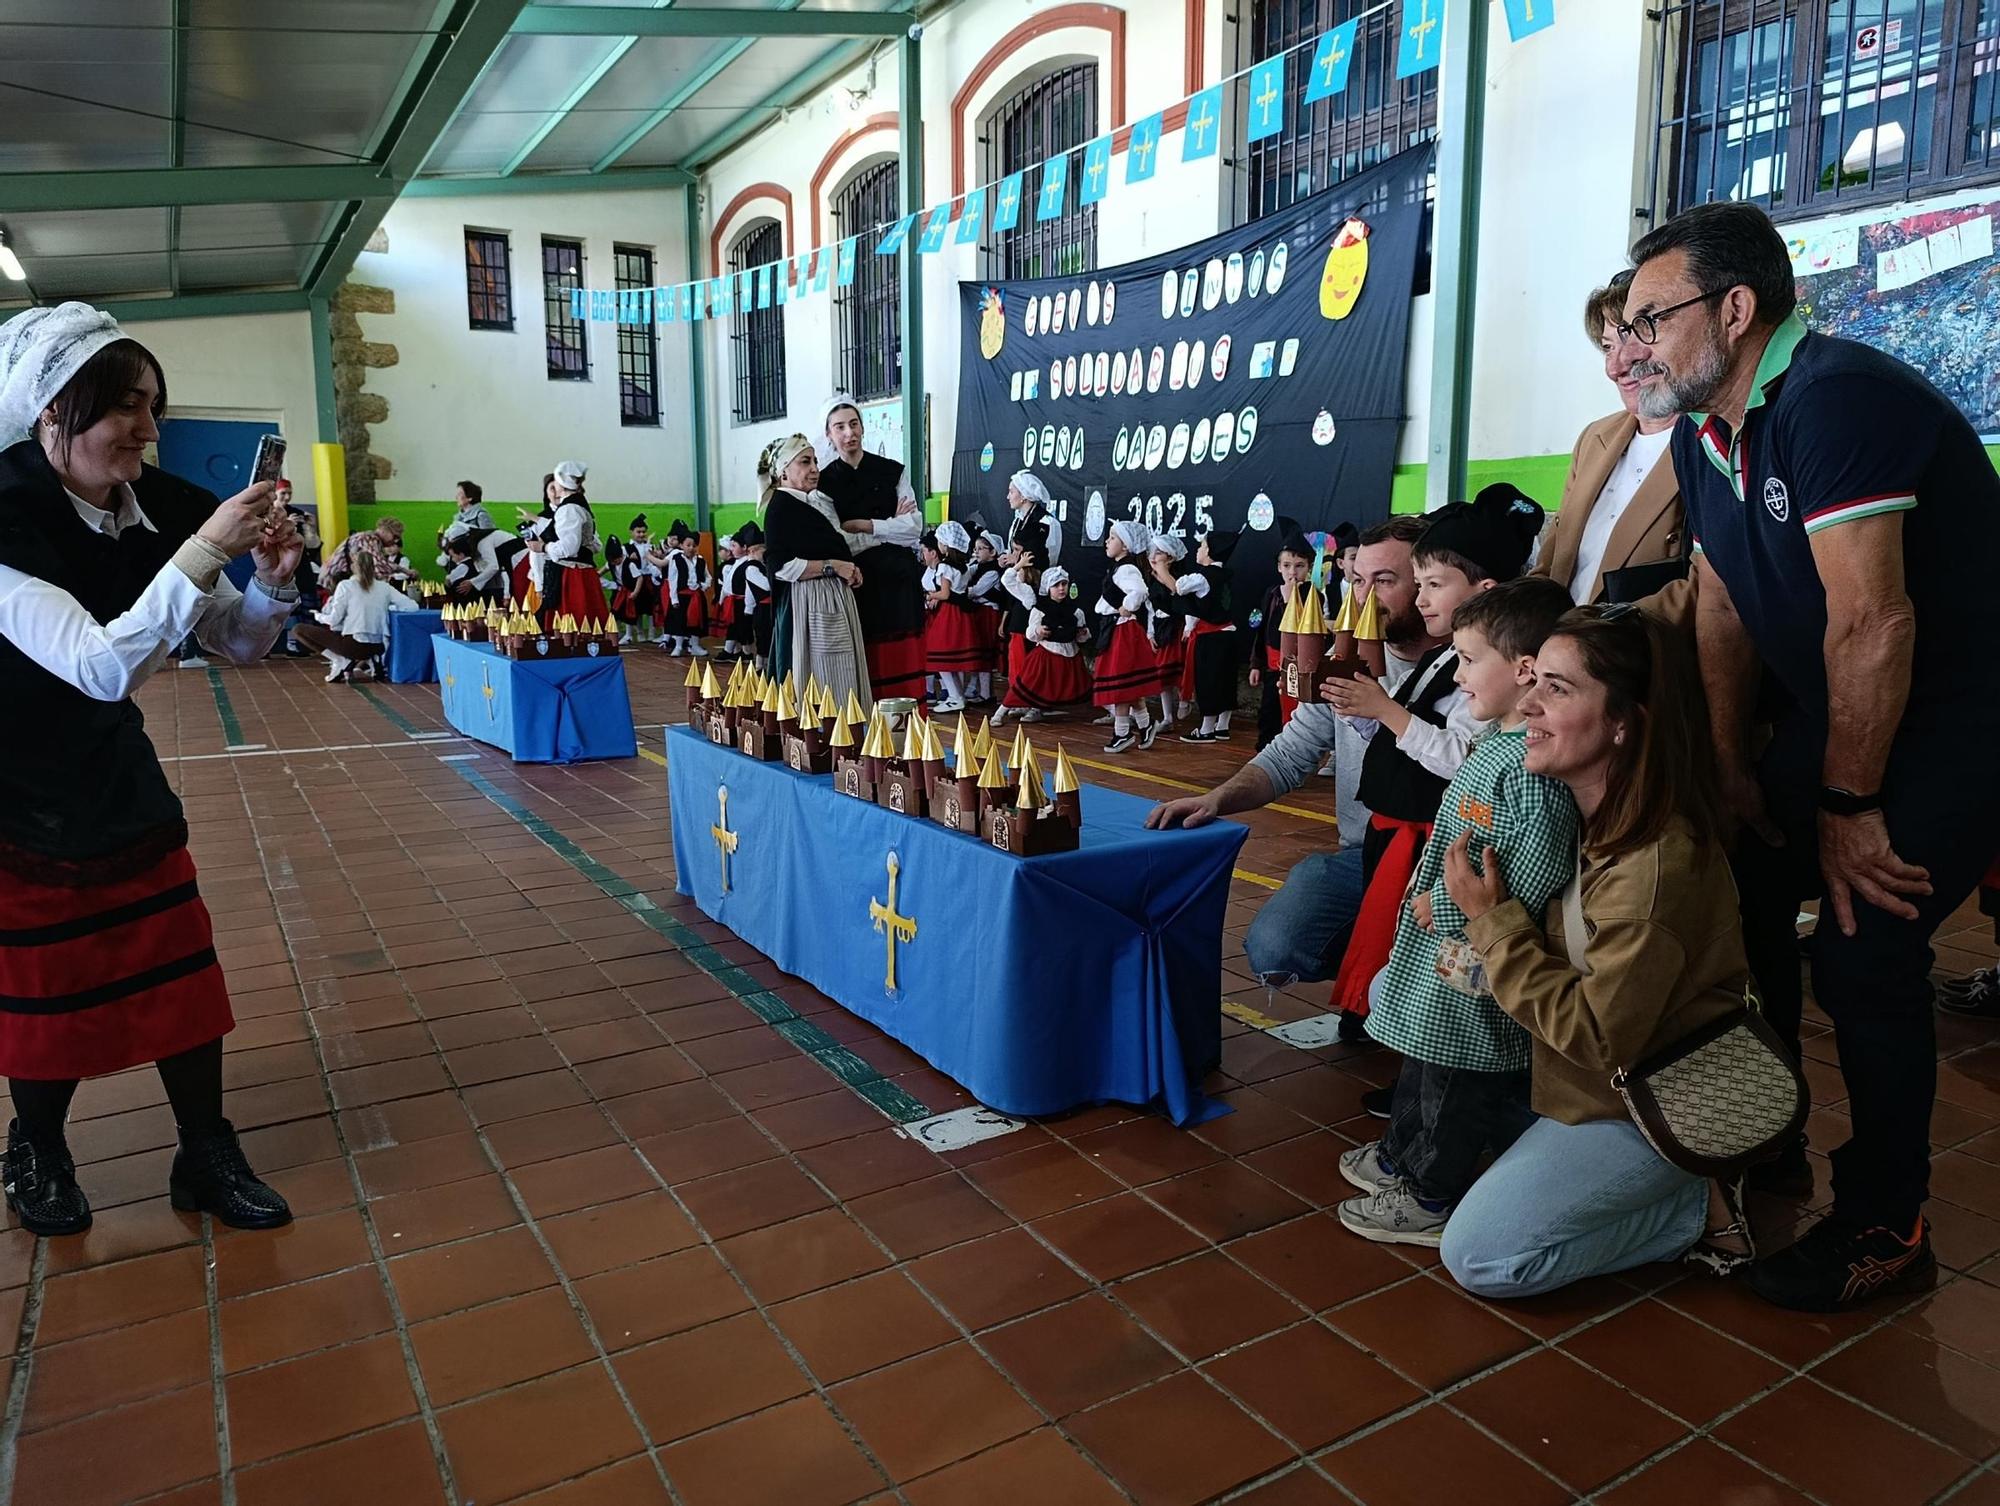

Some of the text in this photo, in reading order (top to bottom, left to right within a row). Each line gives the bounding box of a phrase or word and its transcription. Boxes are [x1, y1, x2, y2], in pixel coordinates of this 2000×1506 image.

[1163, 244, 1286, 319] INTOS
[1051, 336, 1231, 396] SOLIDAROS
[1025, 427, 1083, 467] PEÑA
[1128, 493, 1213, 540] 2025
